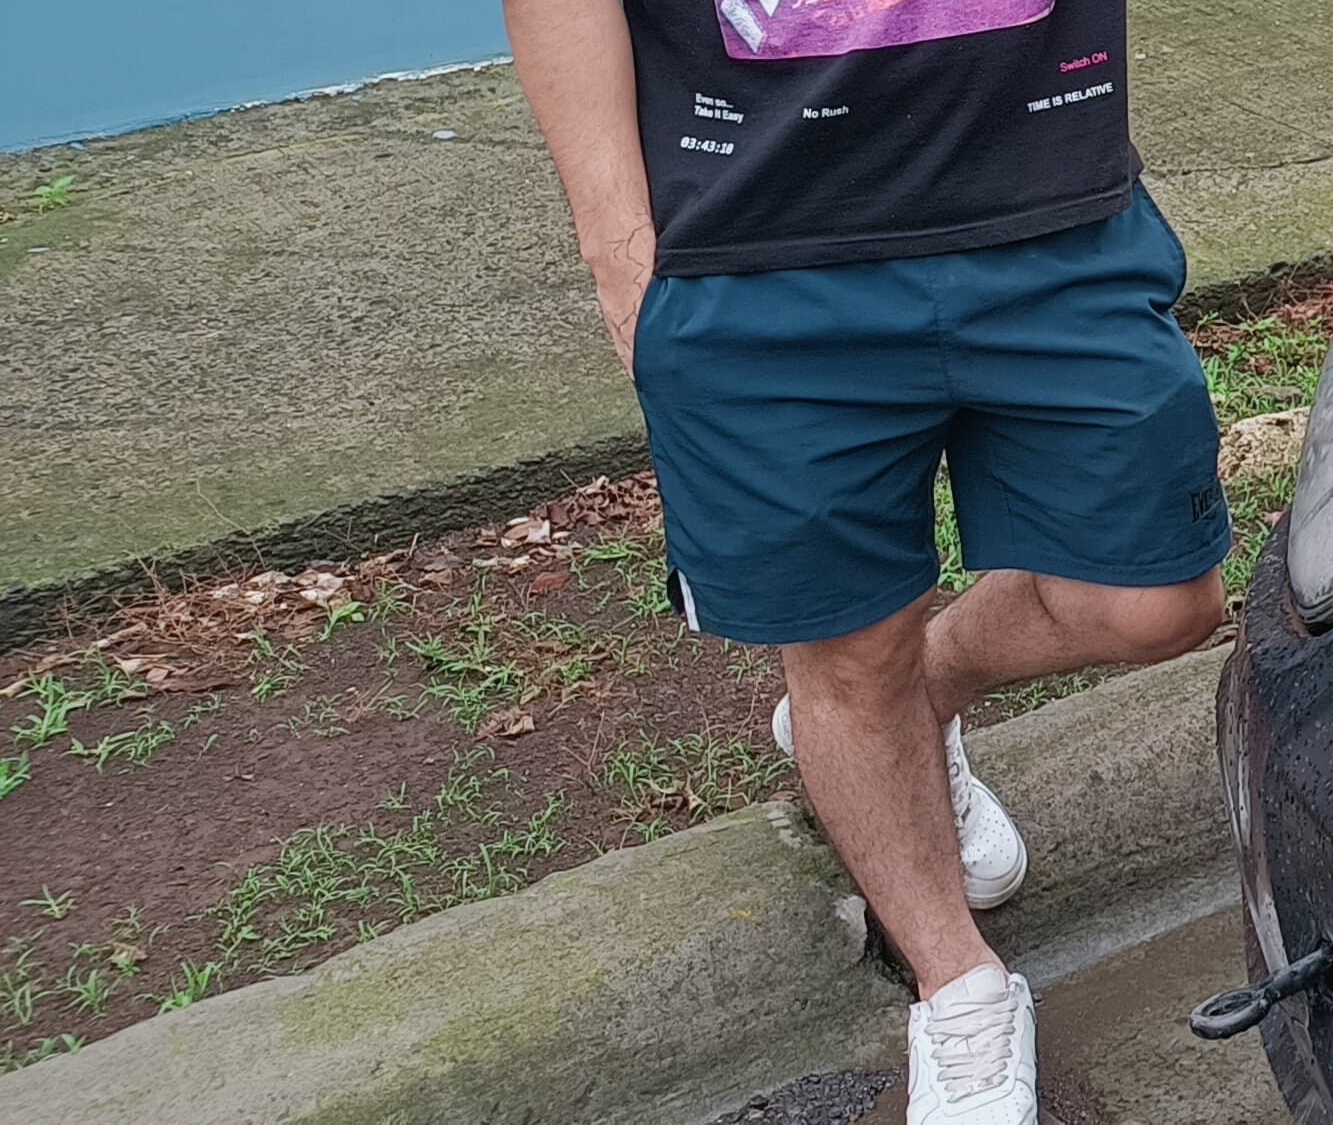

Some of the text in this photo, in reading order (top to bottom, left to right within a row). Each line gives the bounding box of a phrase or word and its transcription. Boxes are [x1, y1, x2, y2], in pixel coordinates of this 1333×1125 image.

[1060, 51, 1108, 73] Switch ON
[1027, 82, 1114, 113] TIME IS RELATIVE
[694, 104, 714, 118] Take
[722, 109, 744, 124] Easy
[802, 105, 850, 120] No Rush
